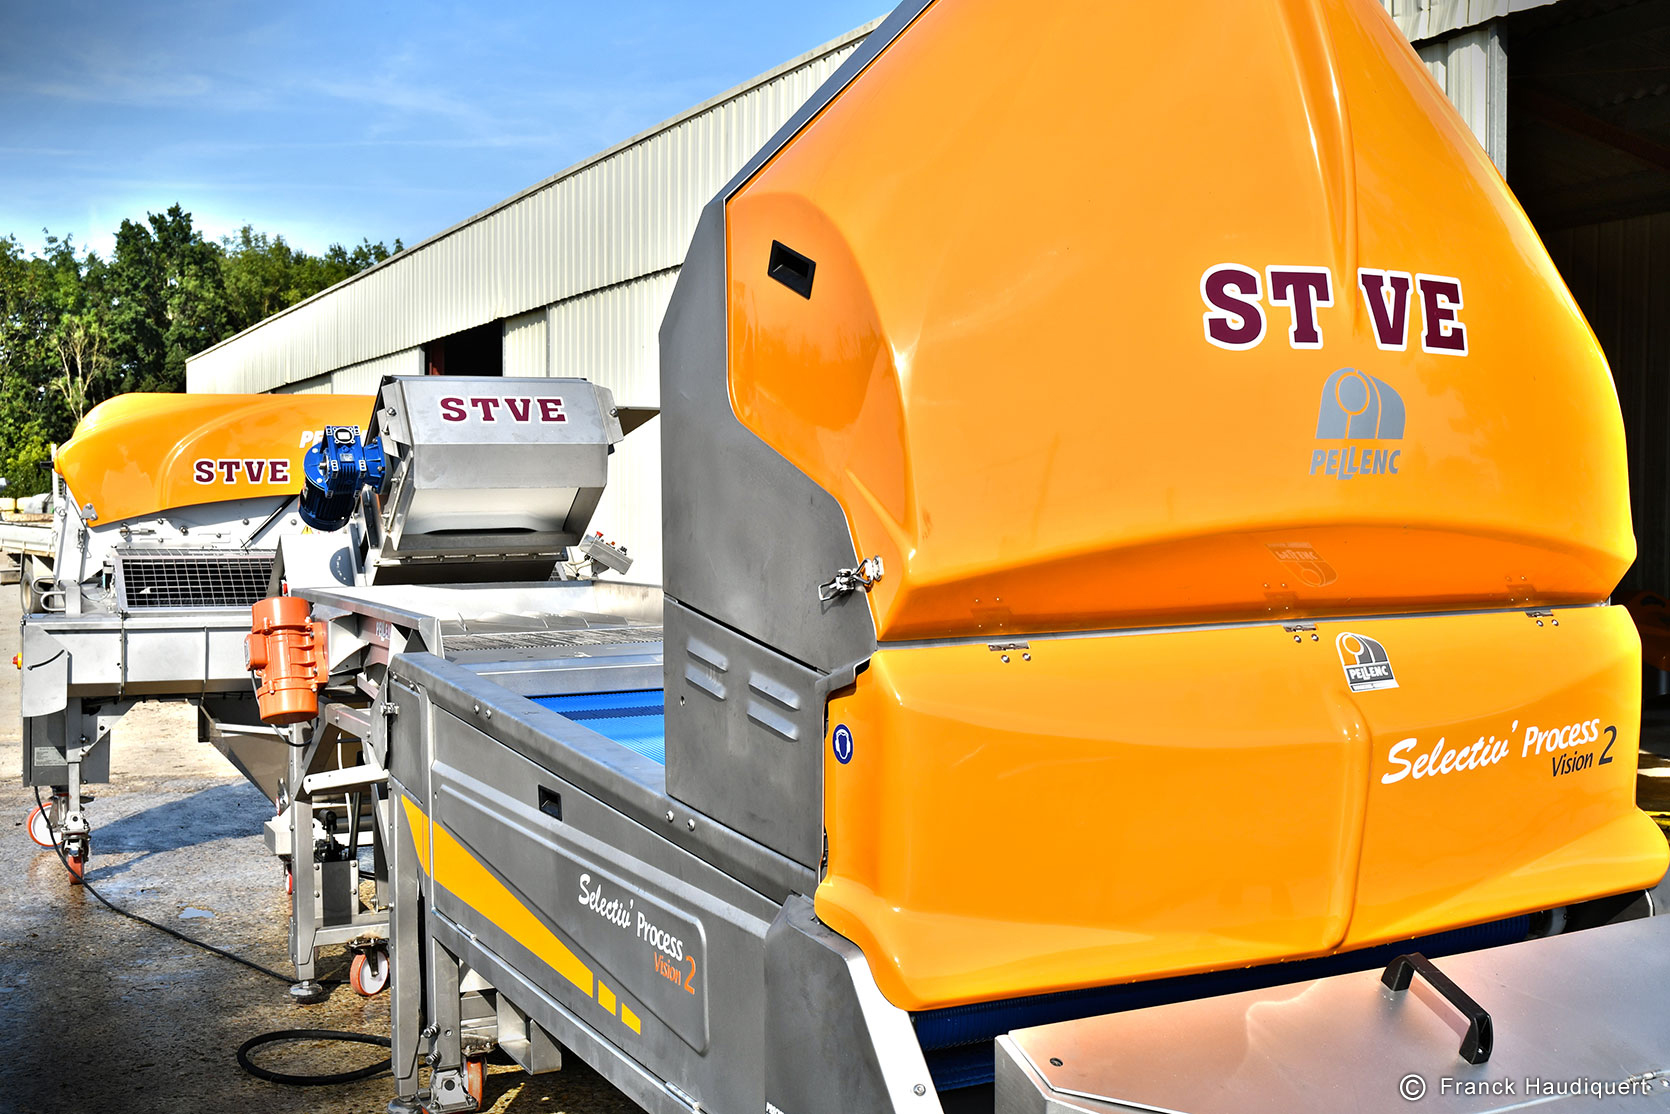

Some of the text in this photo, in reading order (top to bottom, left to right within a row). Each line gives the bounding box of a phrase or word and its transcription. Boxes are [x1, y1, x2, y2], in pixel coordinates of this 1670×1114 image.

[438, 395, 568, 424] STVE
[193, 458, 290, 485] STVE
[1309, 446, 1401, 480] PELLENC
[1348, 665, 1389, 681] PELLENC
[1521, 718, 1600, 758] Process
[1551, 725, 1617, 777] Vision 2
[636, 911, 684, 961] Process
[654, 951, 696, 995] Vision 2
